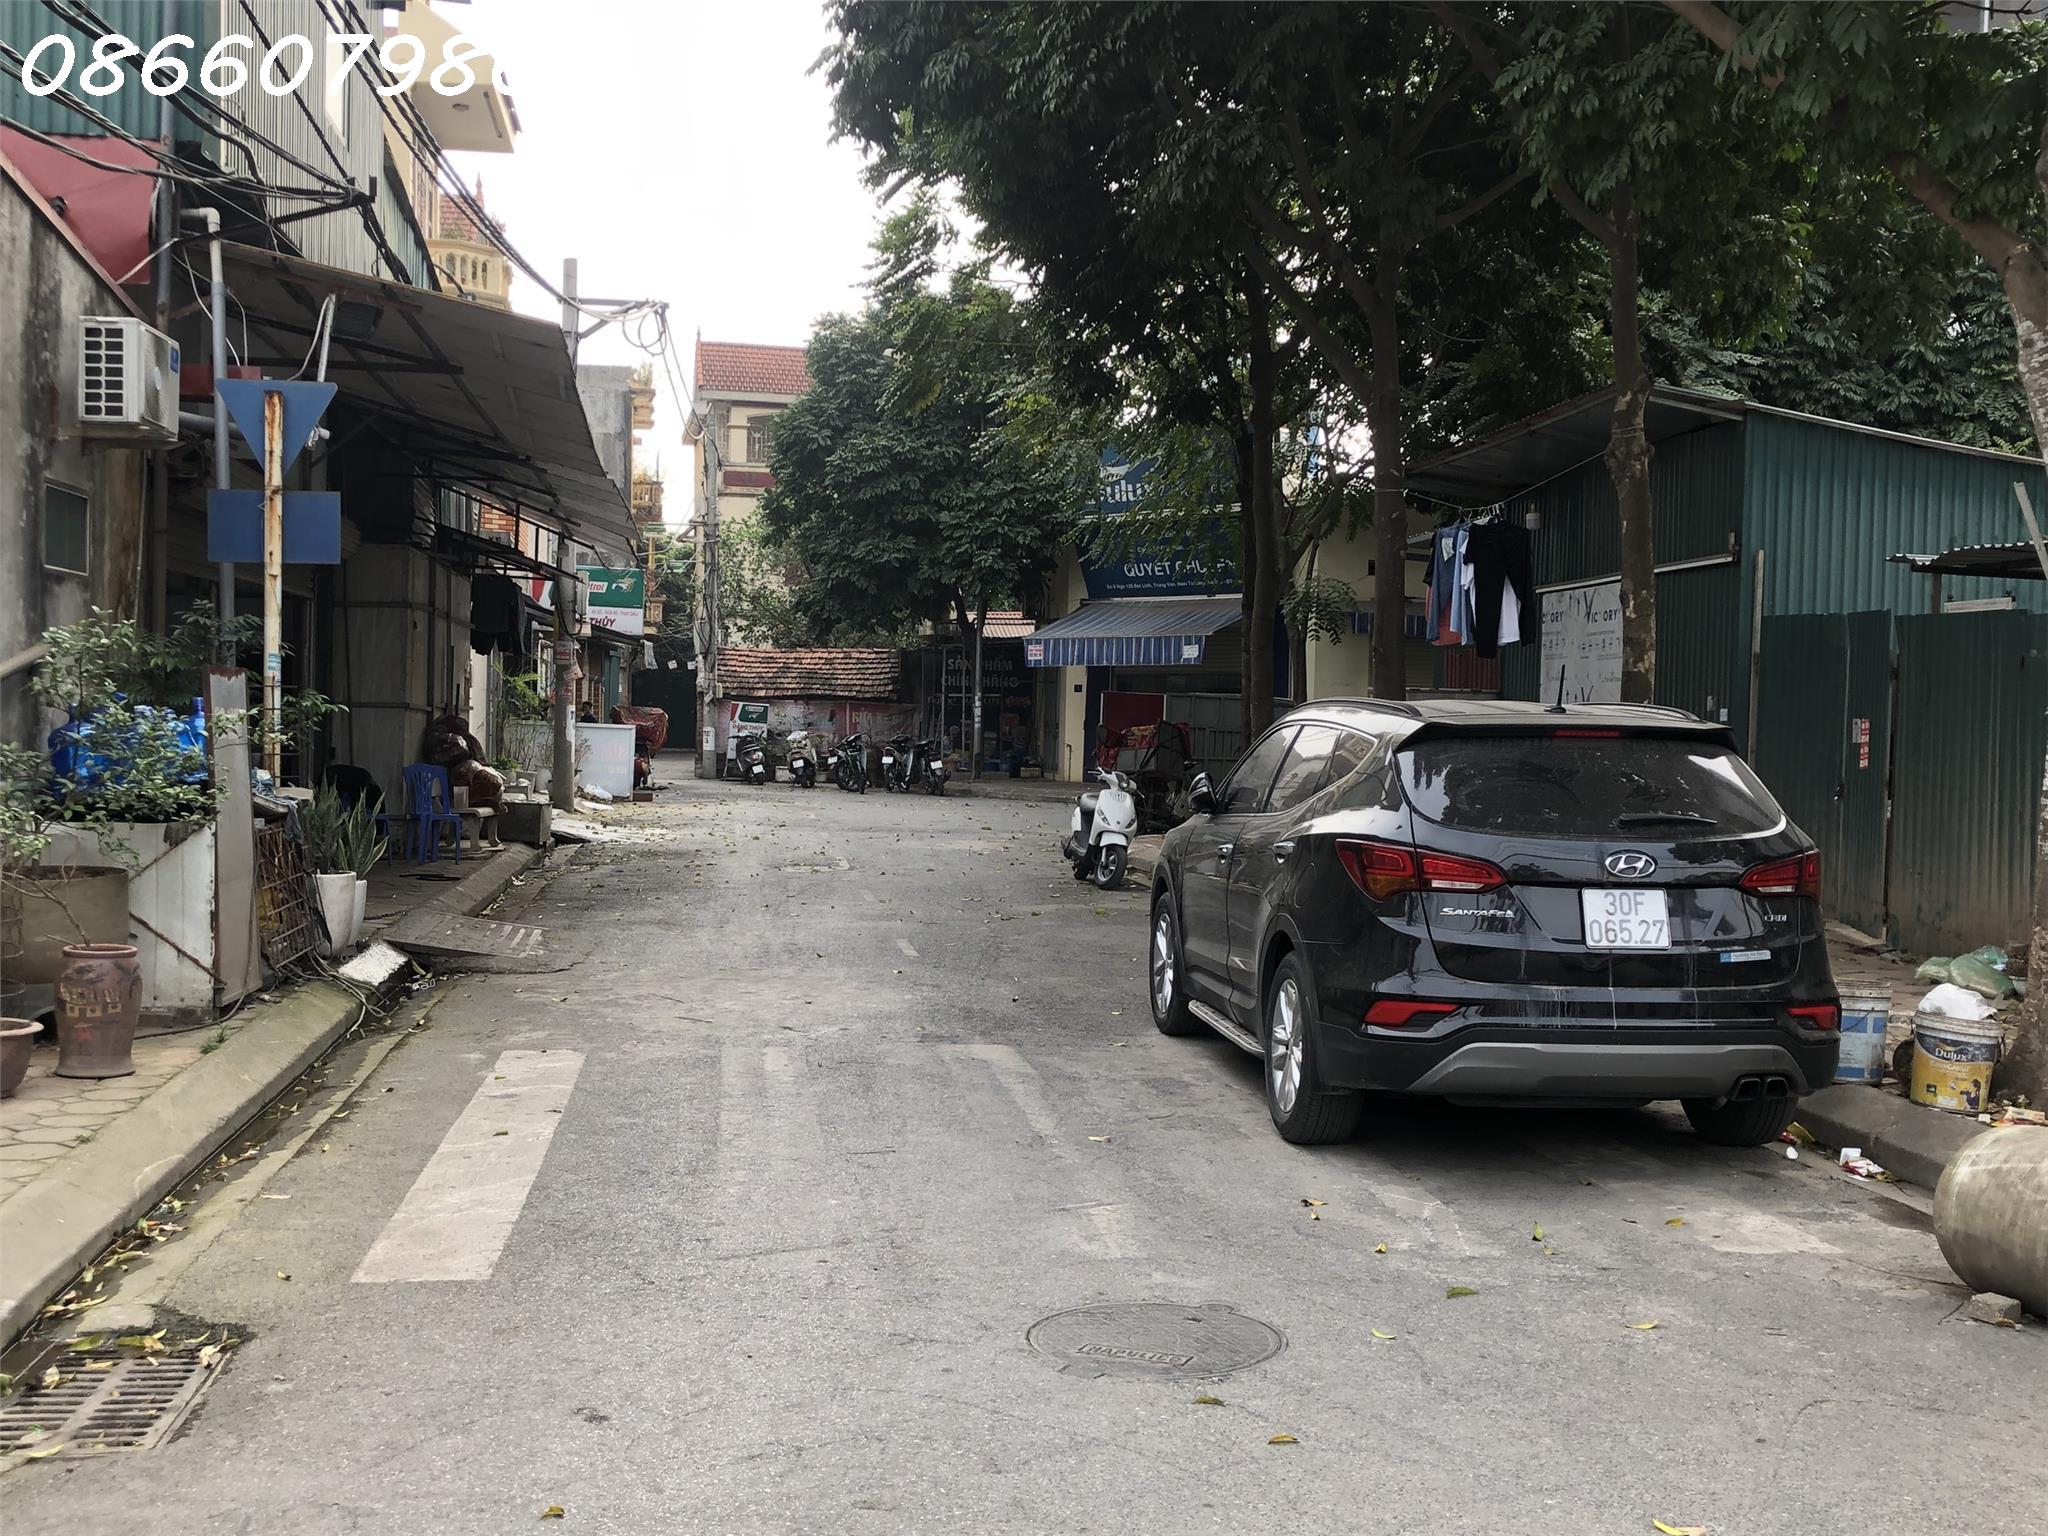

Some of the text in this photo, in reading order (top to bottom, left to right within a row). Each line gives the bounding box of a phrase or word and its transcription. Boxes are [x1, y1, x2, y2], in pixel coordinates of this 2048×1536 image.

[1604, 891, 1645, 916] 30F
[1589, 919, 1666, 945] 065.27
[1935, 1047, 1967, 1062] Dulux
